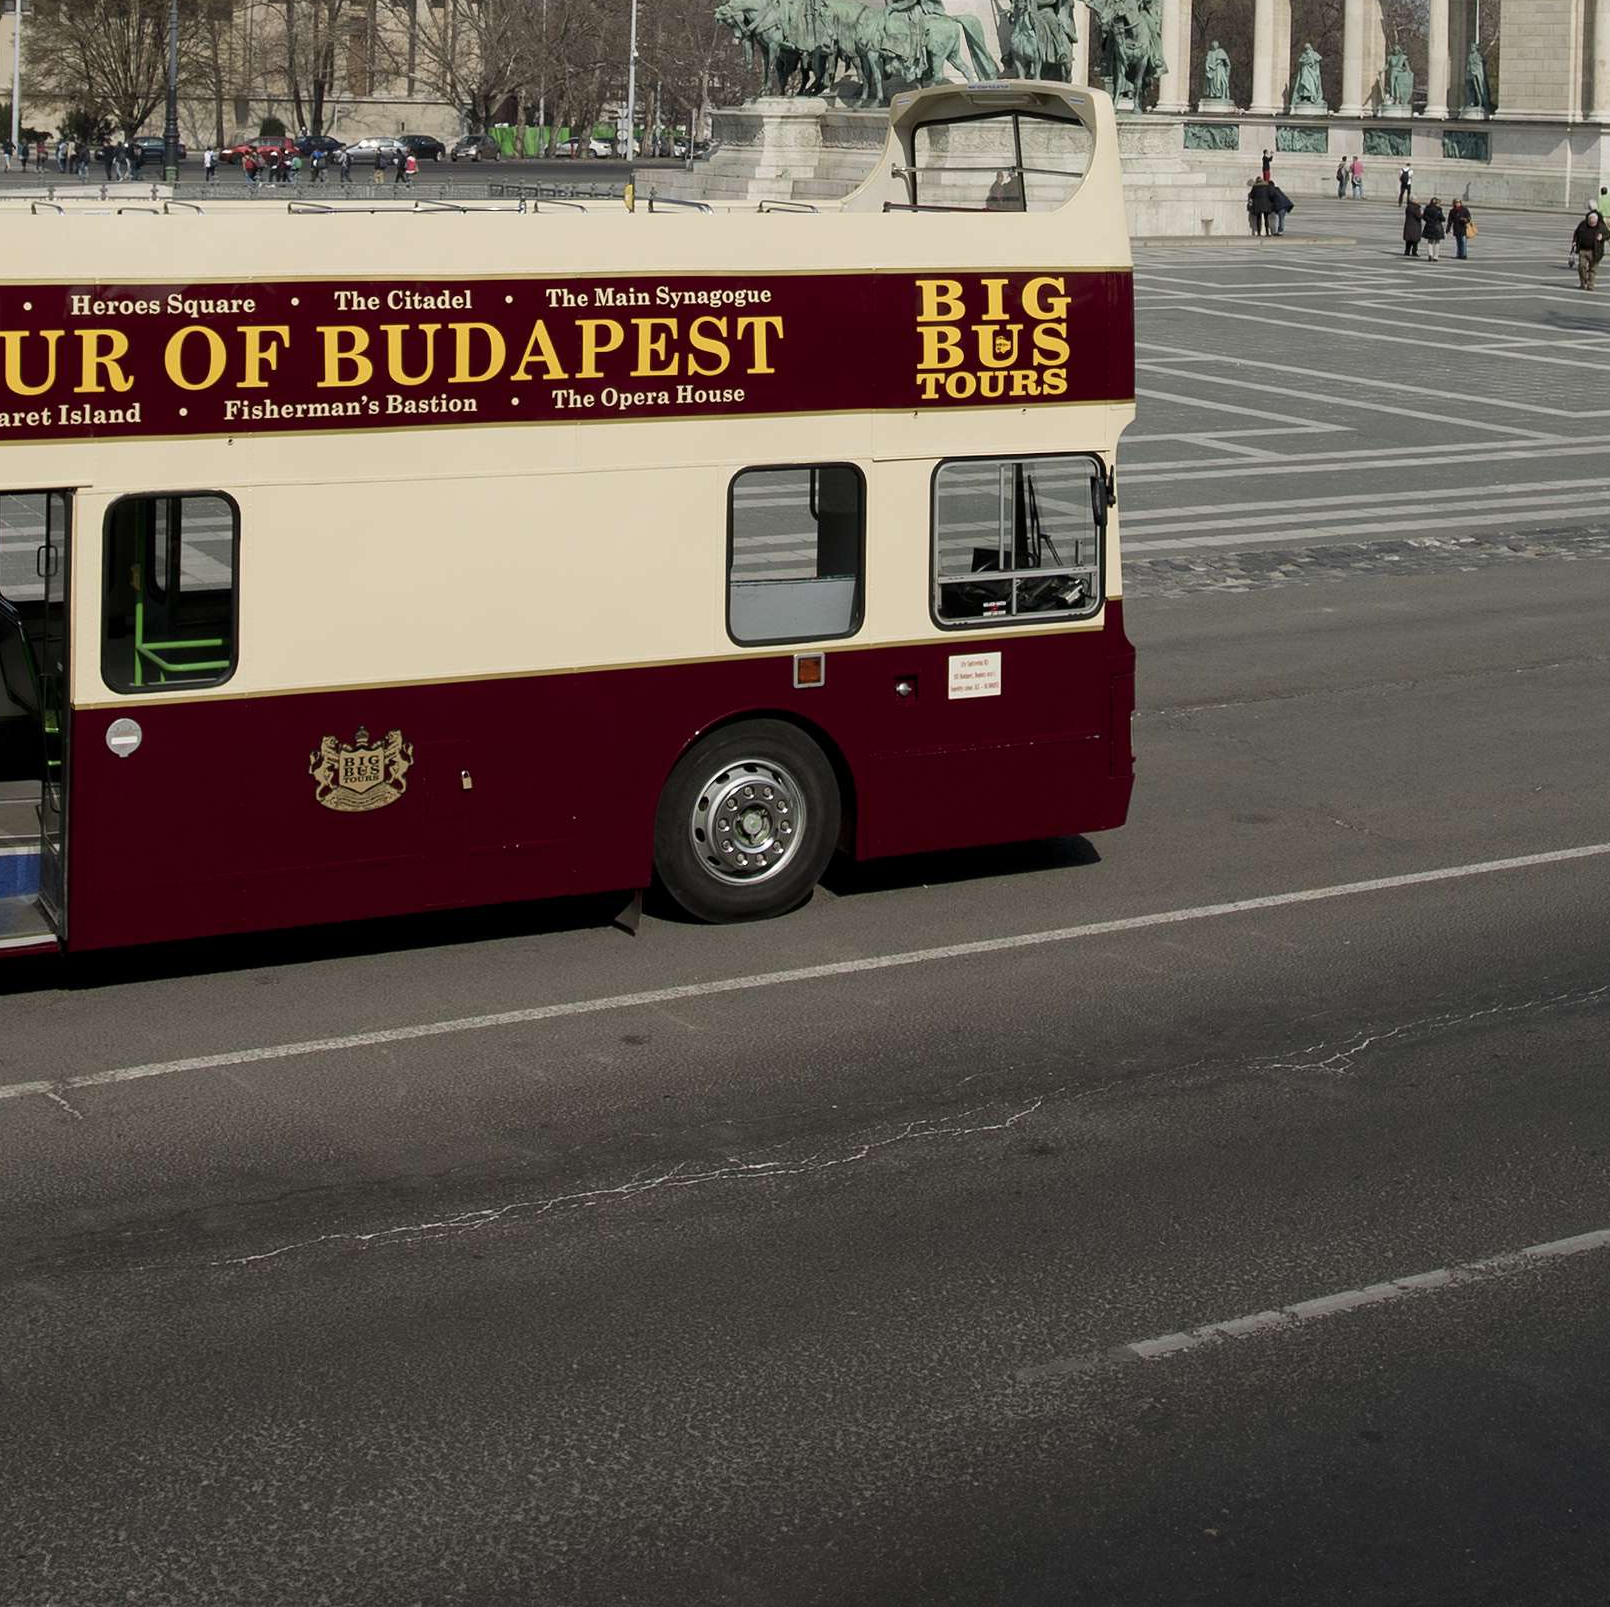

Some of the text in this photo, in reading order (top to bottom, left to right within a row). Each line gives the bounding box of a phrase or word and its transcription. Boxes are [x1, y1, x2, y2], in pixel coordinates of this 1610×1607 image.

[71, 295, 160, 316] Heroes
[168, 294, 255, 319] Square
[334, 291, 379, 311] The
[388, 290, 472, 310] Citadel
[546, 288, 588, 308] The
[594, 287, 650, 307] Main
[656, 285, 771, 310] Synagogue
[916, 277, 1071, 323] BIG
[164, 325, 289, 391] OF
[316, 315, 784, 388] BUDAPEST
[917, 322, 1071, 370] BUS
[917, 367, 1068, 400] TOURS
[59, 403, 141, 426] Island
[224, 397, 379, 421] Fisherman's
[386, 393, 477, 414] Bastion
[552, 390, 594, 409] The
[601, 387, 669, 414] Opera
[676, 385, 744, 405] House
[344, 755, 379, 766] BIG
[344, 765, 380, 777] BUS
[343, 775, 379, 783] TOURS
